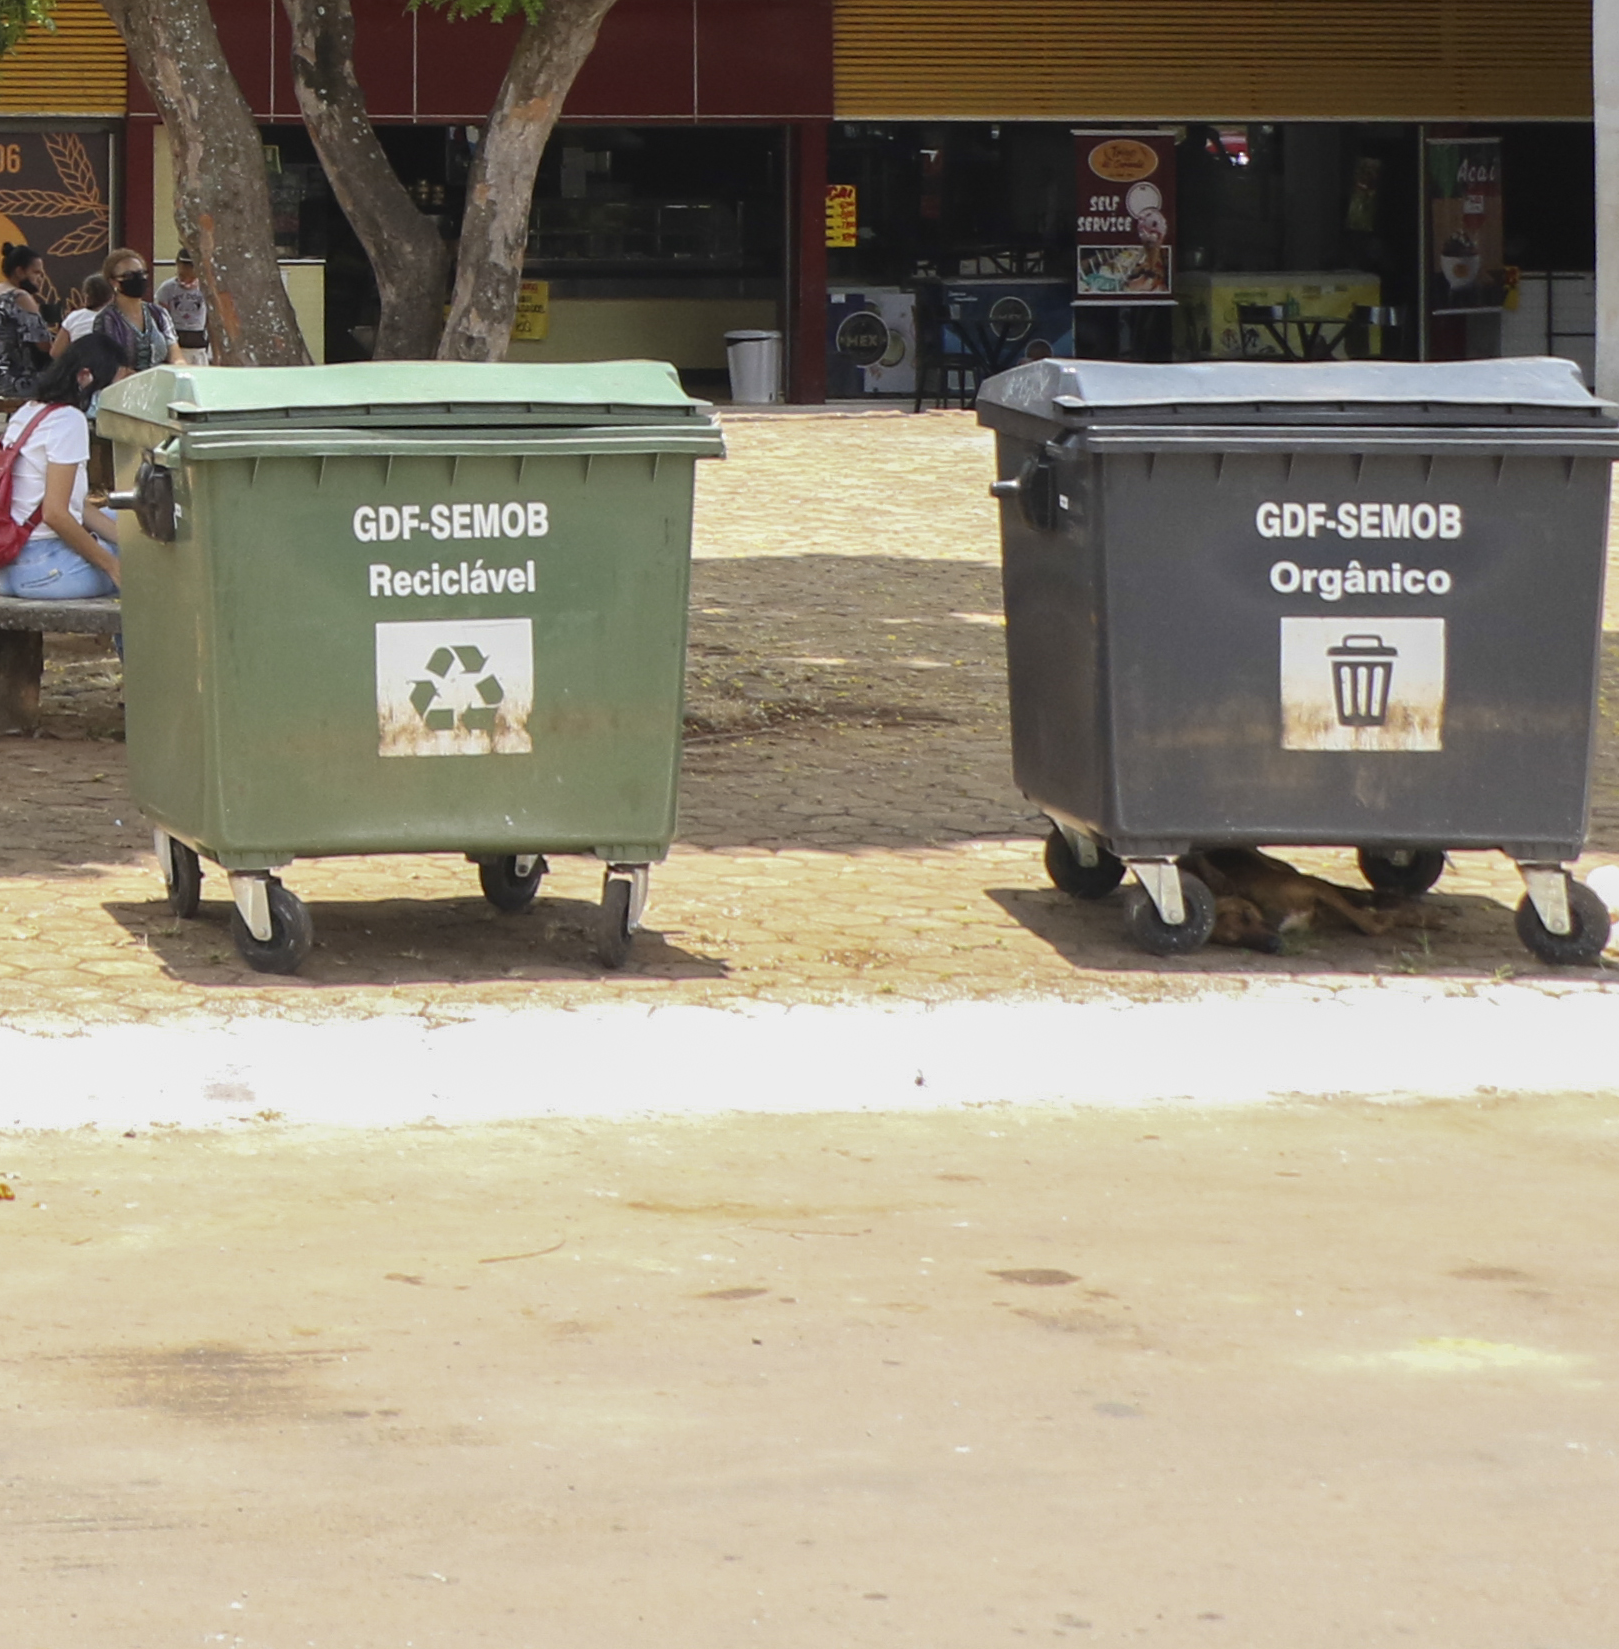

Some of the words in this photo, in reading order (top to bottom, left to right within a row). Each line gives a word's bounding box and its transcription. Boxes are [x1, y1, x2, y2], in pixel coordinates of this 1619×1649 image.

[1089, 196, 1121, 212] SELF
[1076, 216, 1132, 233] SERVICE
[353, 502, 549, 542] GDF-SEMOB
[1256, 503, 1462, 539] GDF-SEMOB
[369, 559, 536, 597] Reciclável
[1269, 560, 1452, 601] Orgânico
